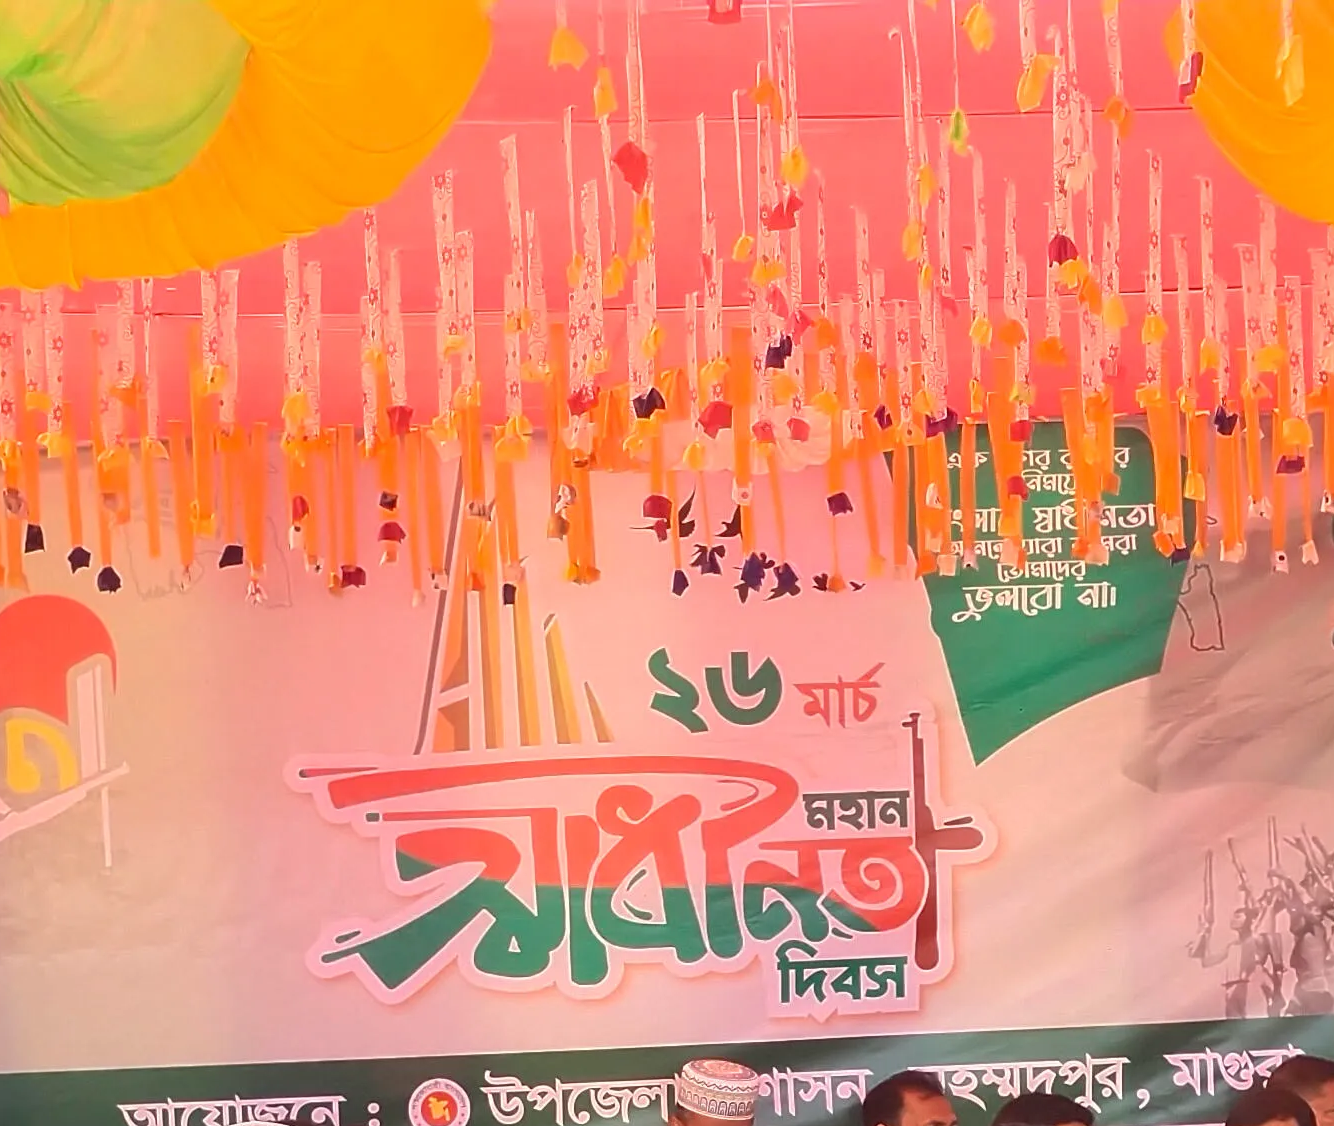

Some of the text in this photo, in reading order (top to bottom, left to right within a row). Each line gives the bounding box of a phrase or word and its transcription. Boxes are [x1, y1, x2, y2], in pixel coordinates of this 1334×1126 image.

[951, 582, 1064, 623] ভুলবো
[646, 646, 887, 735] ২৬ মার্চ
[802, 788, 910, 831] মহান
[299, 745, 952, 990] স্বাধীনতা
[775, 942, 908, 1005] দিবস
[1163, 1042, 1306, 1097] মাগুর
